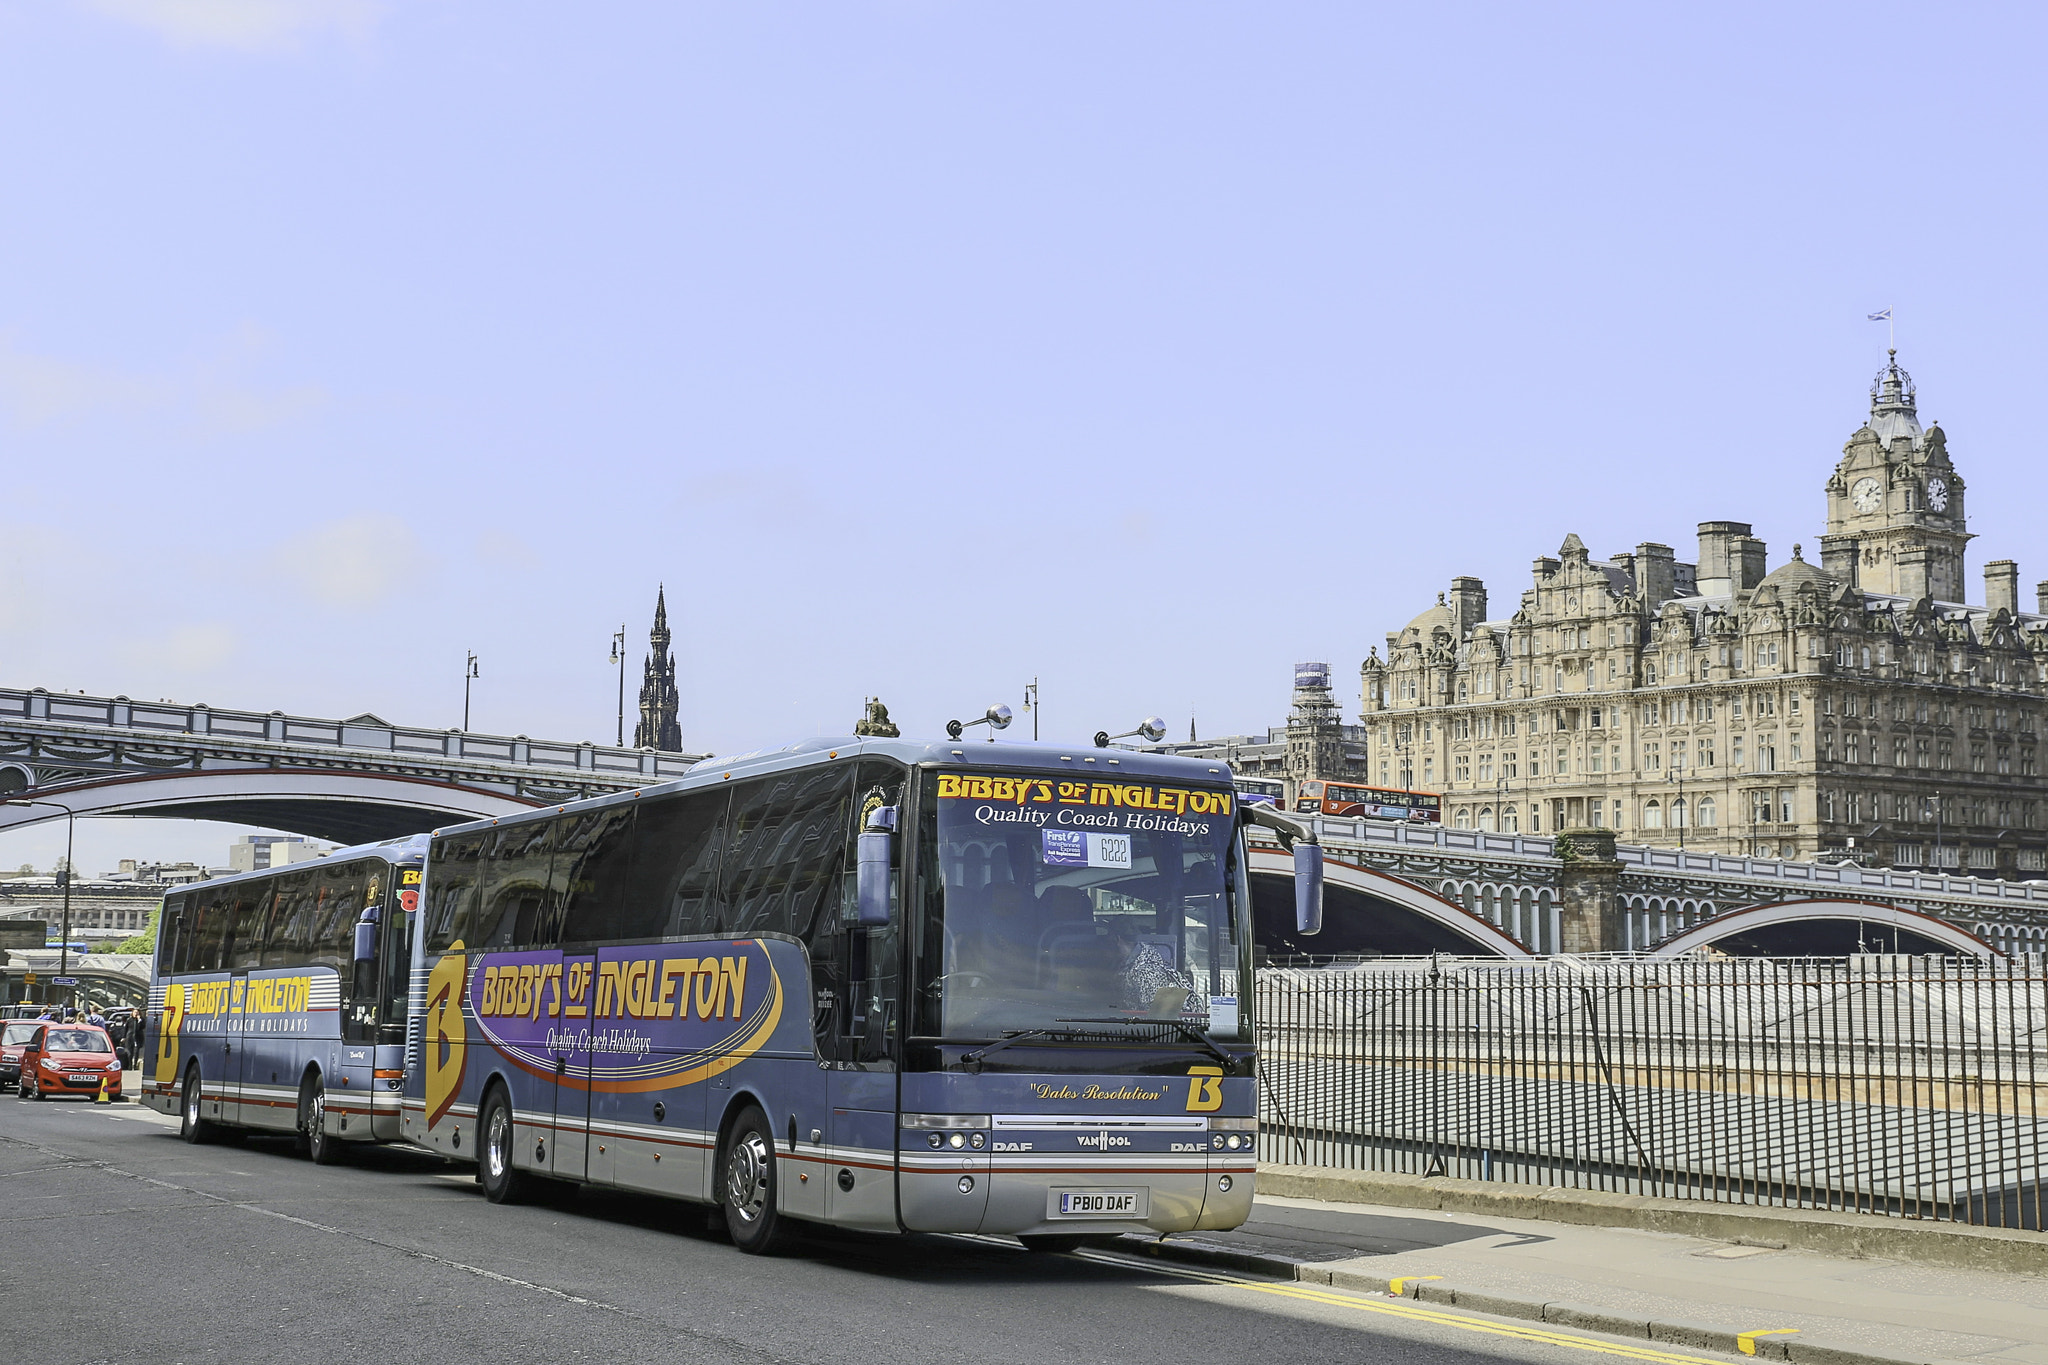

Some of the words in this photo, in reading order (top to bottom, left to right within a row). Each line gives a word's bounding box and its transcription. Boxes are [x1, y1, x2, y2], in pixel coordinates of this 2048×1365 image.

[937, 774, 1055, 806] BIBBY'S
[1058, 782, 1089, 806] OF
[1089, 783, 1231, 817] INGLETON
[975, 805, 1051, 827] Quality
[1057, 809, 1118, 828] Coach
[1123, 813, 1209, 837] Holidays
[1046, 830, 1066, 842] First
[1101, 838, 1127, 862] 6222
[189, 980, 230, 1020] BIBBY'S
[231, 980, 246, 1014] OF
[245, 976, 312, 1014] INGLETON
[481, 964, 562, 1023] BIBBY'S
[565, 962, 592, 1019] OF
[594, 956, 747, 1022] INGLETON
[186, 1019, 220, 1033] QUALITY
[227, 1019, 255, 1032] COACH
[260, 1018, 308, 1032] HOLIDAYS
[545, 1027, 577, 1058] Quality
[578, 1028, 607, 1053] Coach
[609, 1028, 651, 1061] Holidays
[1186, 1066, 1223, 1112] B
[992, 1142, 1033, 1151] DAF
[1170, 1143, 1207, 1151] DAF
[1073, 1196, 1103, 1210] PB10
[1107, 1196, 1133, 1210] DAF
